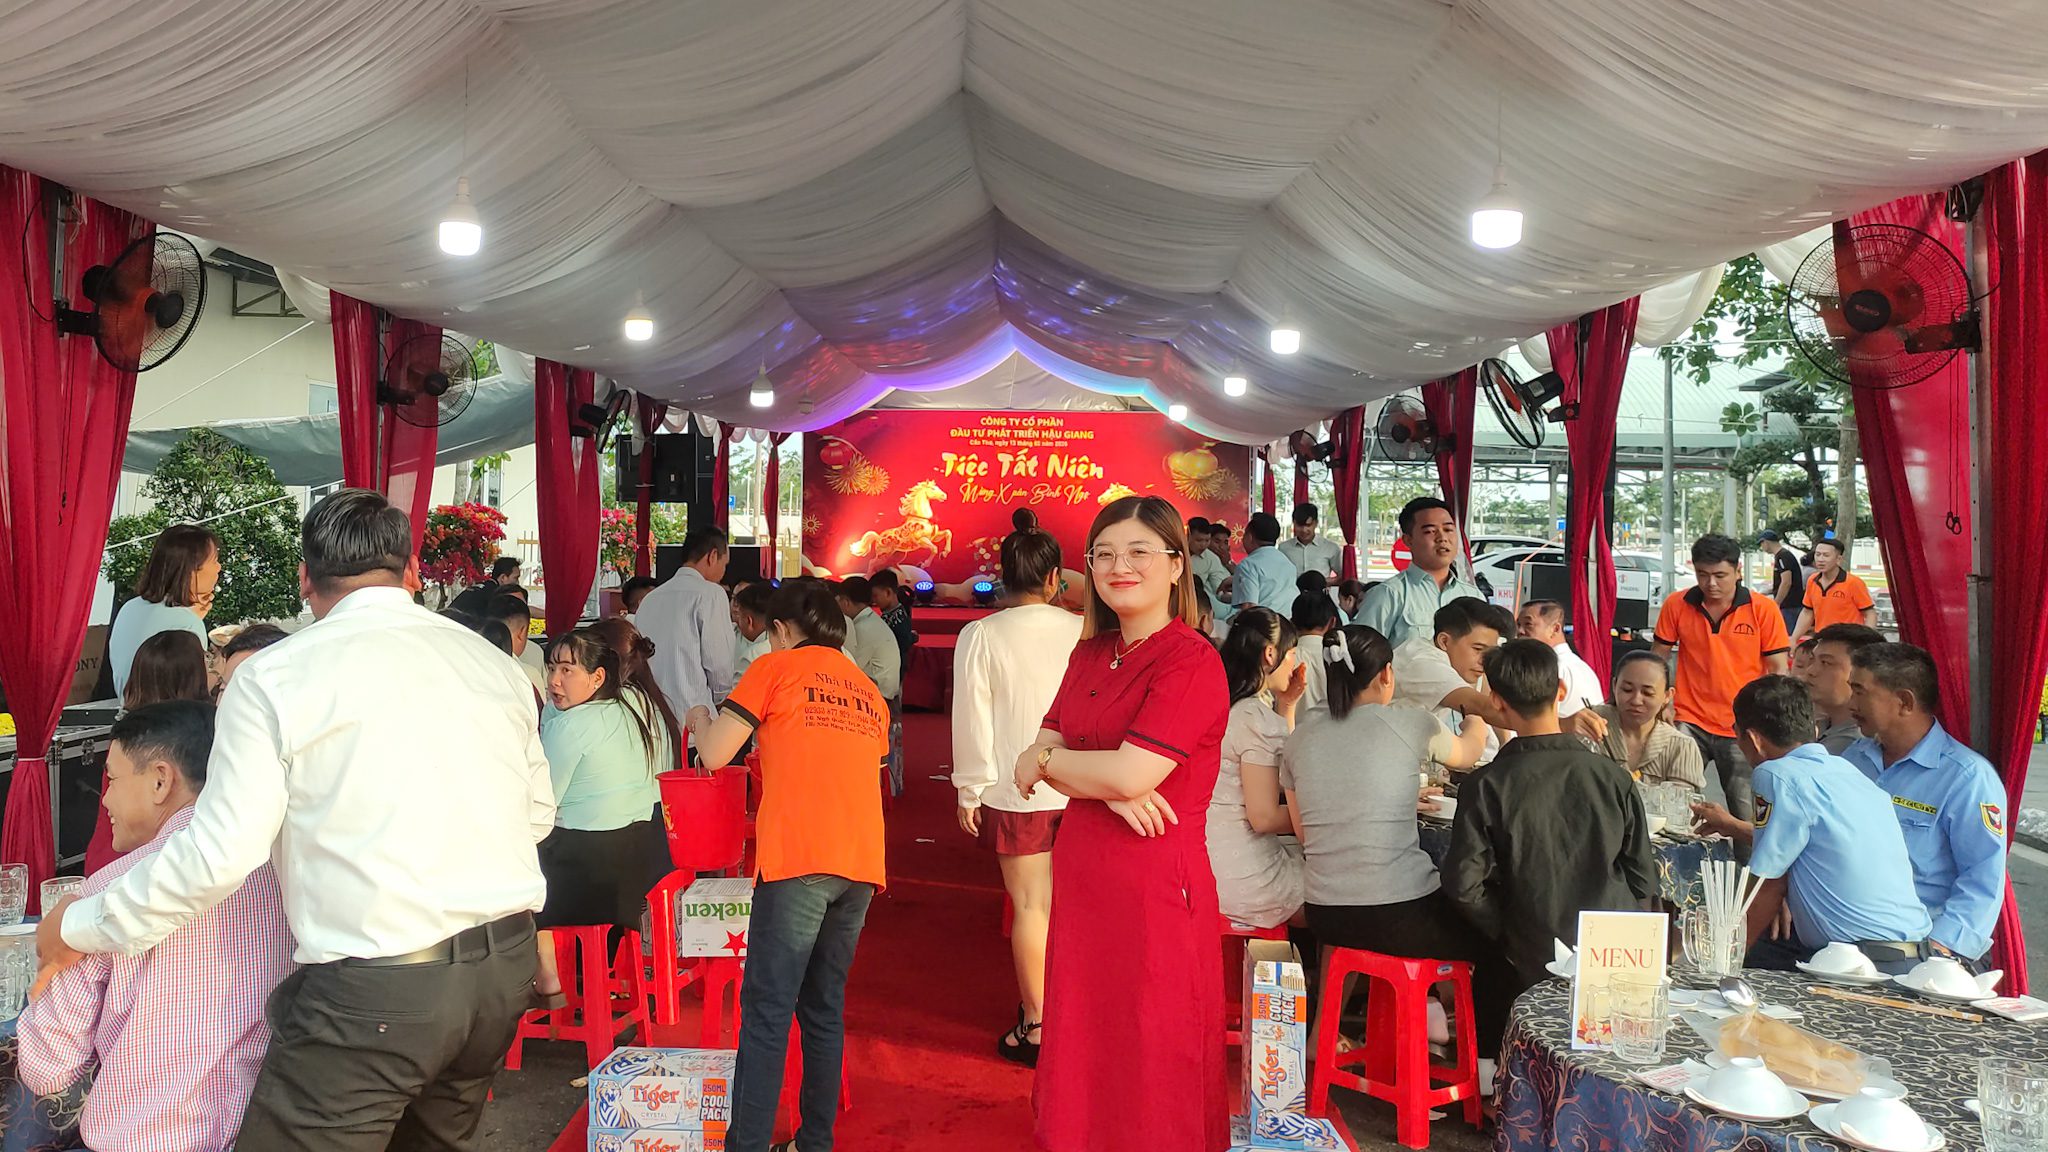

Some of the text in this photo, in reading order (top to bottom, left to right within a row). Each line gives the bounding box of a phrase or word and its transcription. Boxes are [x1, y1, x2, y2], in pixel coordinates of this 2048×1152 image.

[980, 416, 1007, 426] CÔNG
[1009, 418, 1020, 426] TY
[1037, 416, 1064, 427] PHẦN
[950, 427, 1094, 440] ĐẦU TƯ PHÁT TRIỂN HẬU GIANG
[942, 448, 1104, 483] Tiệc Tất Niên
[803, 686, 848, 707] Tiến
[815, 672, 874, 701] Nhà Hàng
[1589, 947, 1654, 969] MENU
[1258, 994, 1267, 1019] 250ML
[1269, 992, 1282, 1022] COOL
[1281, 992, 1296, 1025] PACK
[1259, 1044, 1287, 1100] Tiger
[630, 1083, 680, 1111] Tiger
[703, 1084, 727, 1093] 250ML
[702, 1095, 730, 1108] COOL
[700, 1107, 729, 1121] PACK
